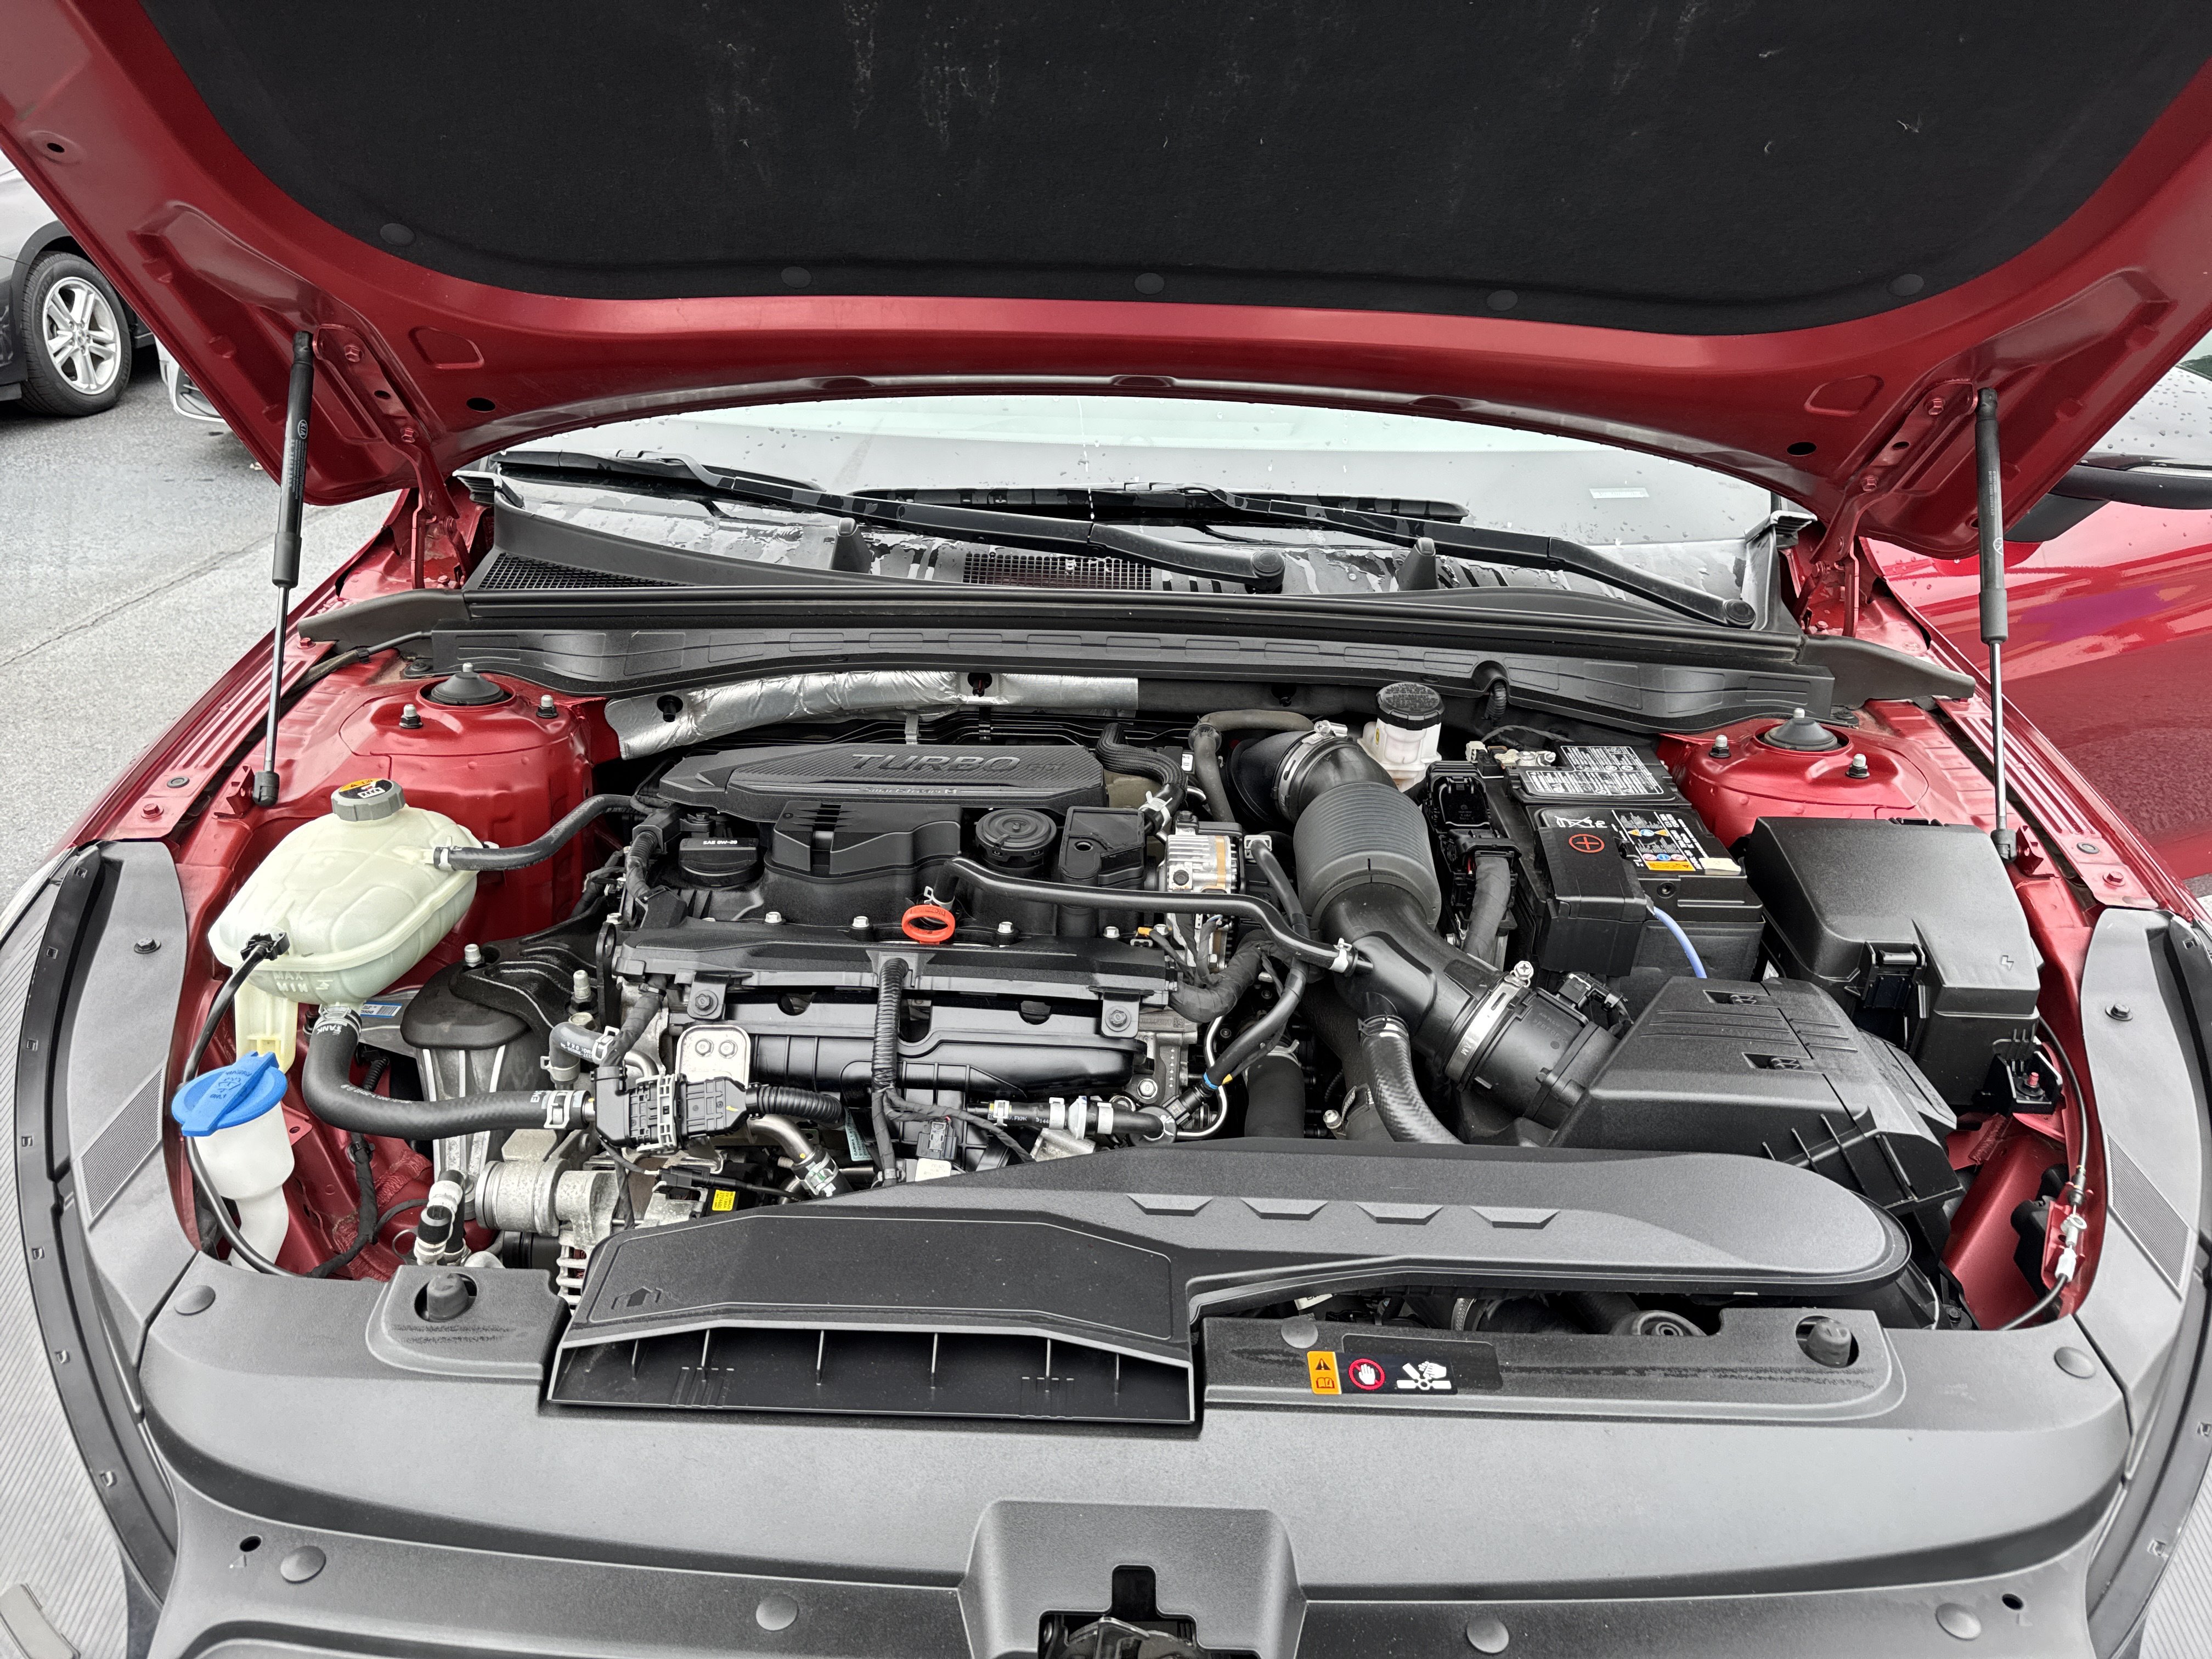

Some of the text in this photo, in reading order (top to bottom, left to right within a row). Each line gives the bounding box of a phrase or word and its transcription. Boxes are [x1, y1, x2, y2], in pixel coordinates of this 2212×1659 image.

[851, 754, 1020, 771] TURBO
[273, 972, 303, 980] MAX
[276, 982, 308, 992] MIN
[317, 1024, 342, 1035] TANK
